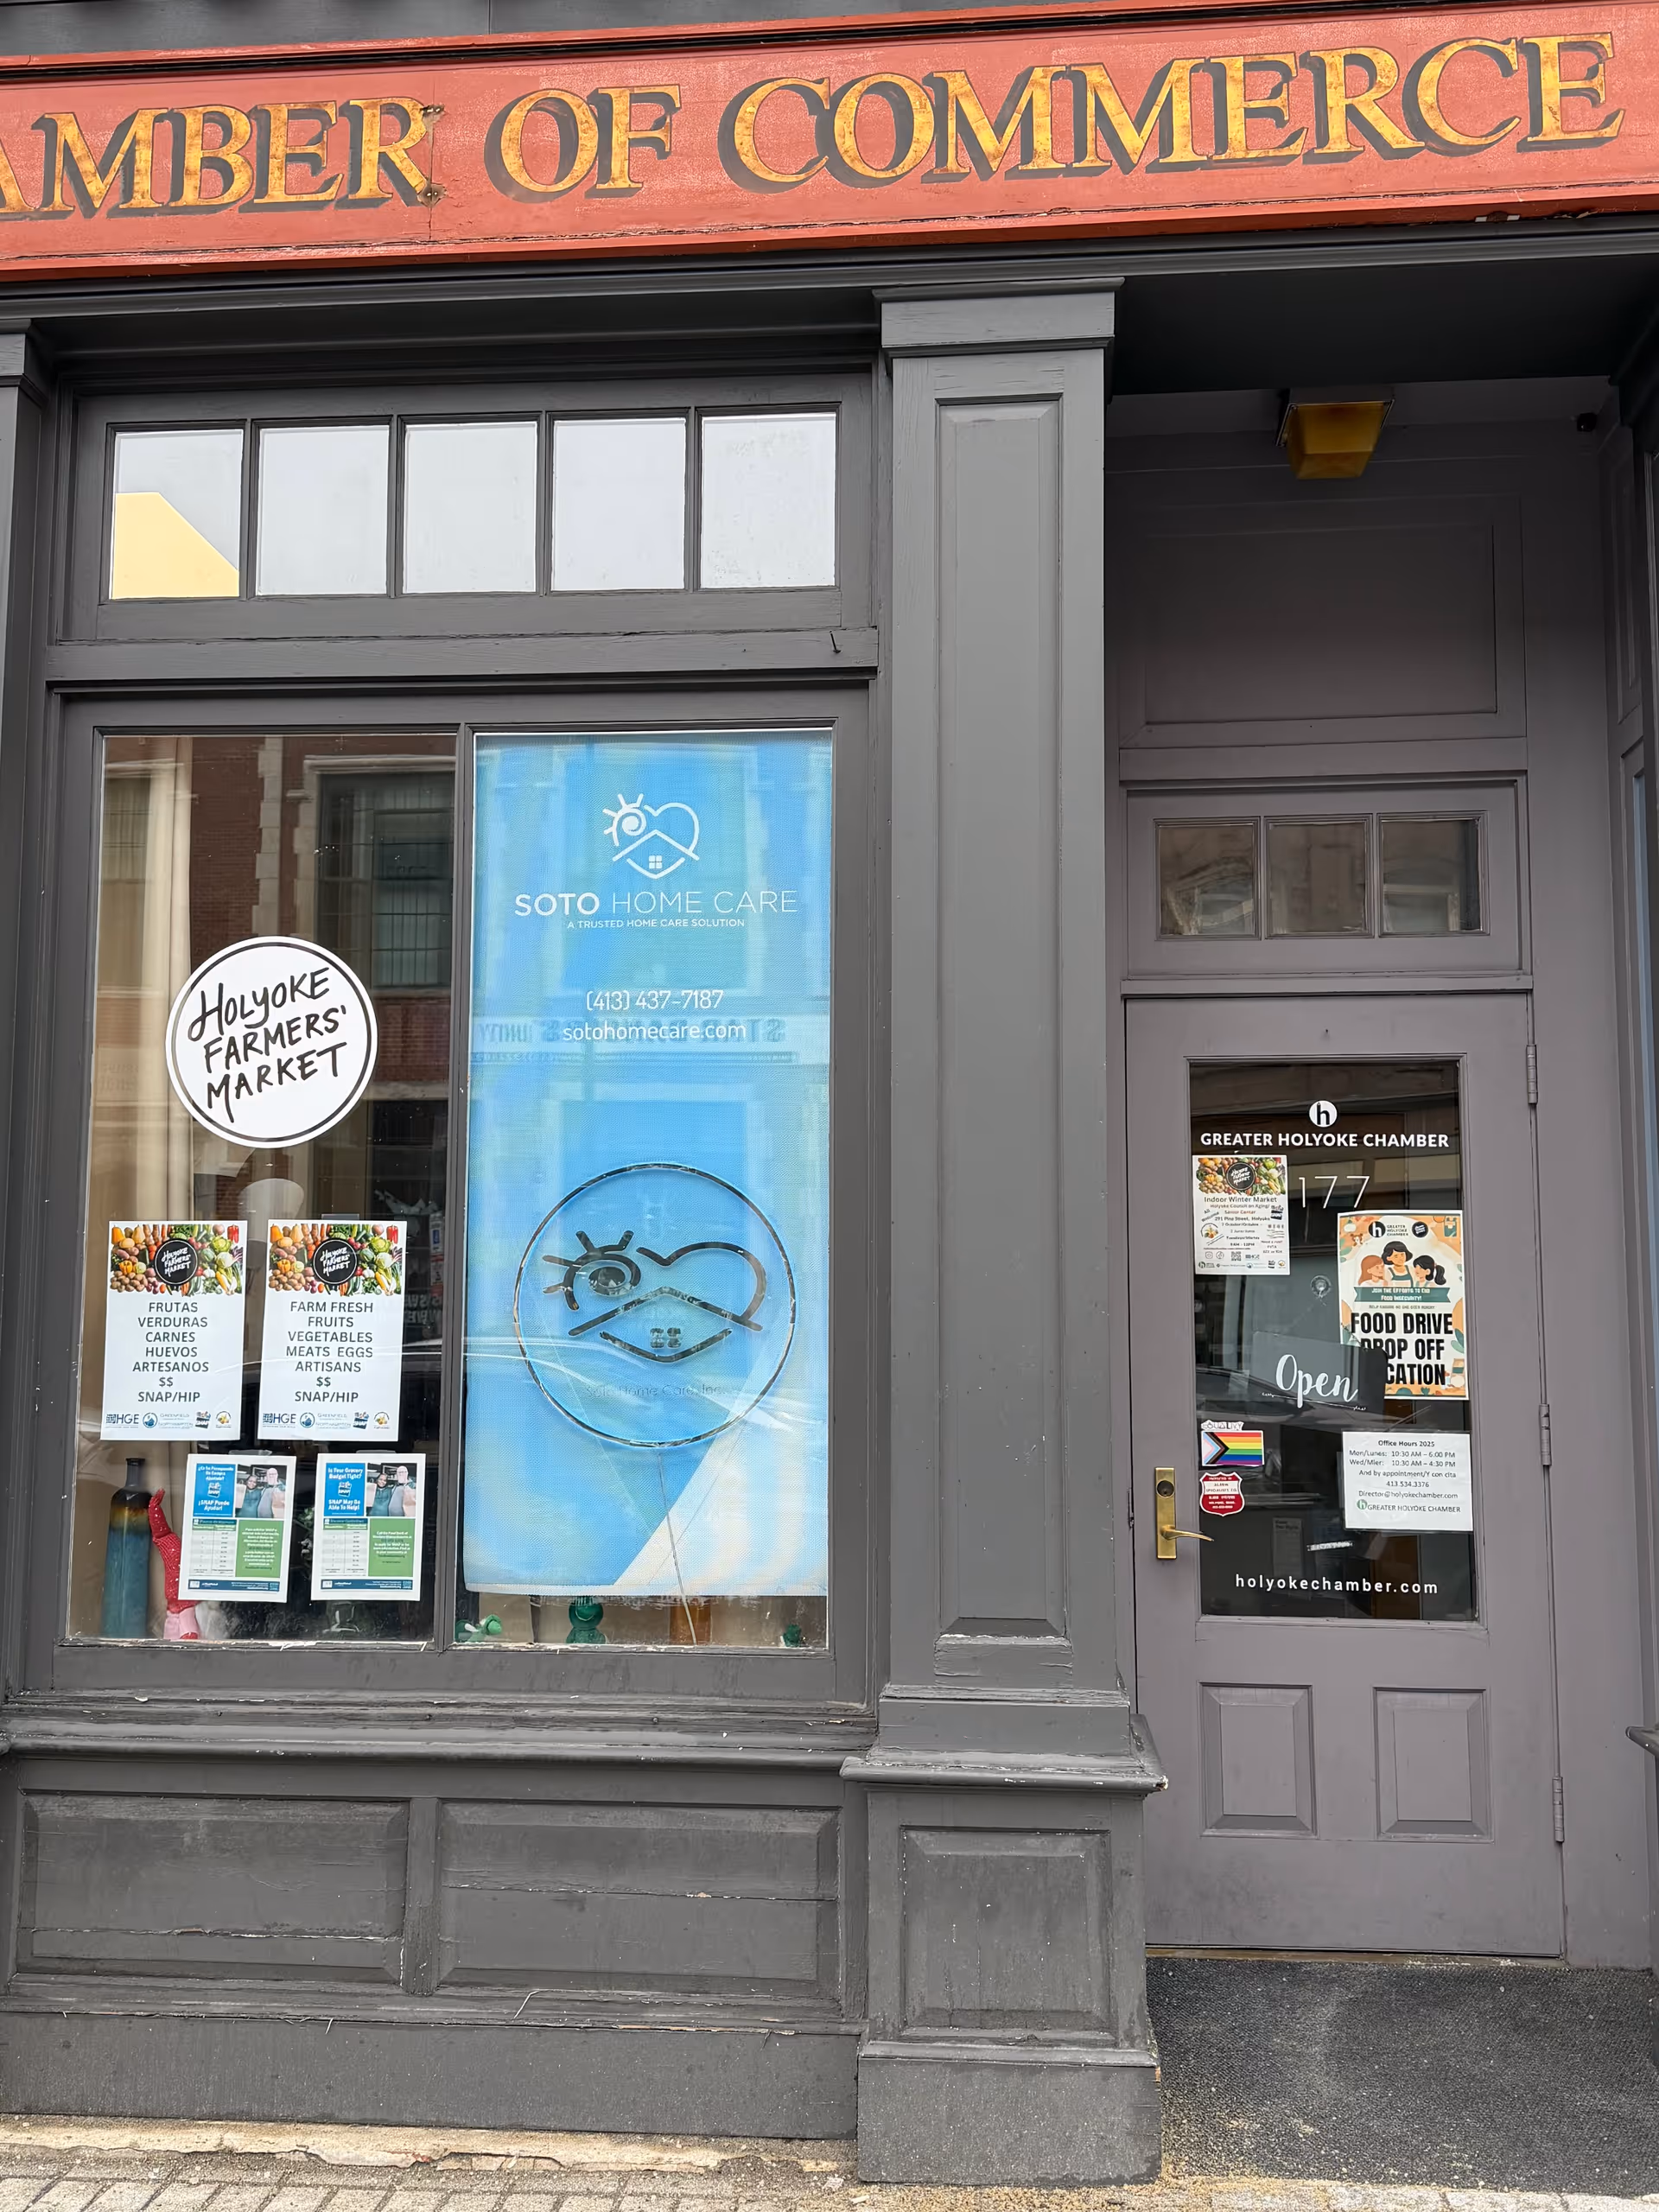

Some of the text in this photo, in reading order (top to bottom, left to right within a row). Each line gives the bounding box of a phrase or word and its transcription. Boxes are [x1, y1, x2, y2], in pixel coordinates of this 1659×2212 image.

[486, 84, 682, 203] OF
[719, 32, 1625, 193] COMMERCE
[514, 890, 798, 916] SOTO HOME CARE
[567, 918, 745, 929] A TRUSTED HOME CARE SOLUTION
[187, 967, 330, 1042] HOLYOKE
[586, 989, 724, 1011] (413) 437-7187
[563, 1020, 747, 1041] sotohomecare.com
[203, 1004, 347, 1073] FARMERS'
[207, 1041, 347, 1124] MARKET
[1200, 1132, 1450, 1148] GREATER HOLYOKE CHAMBER
[1299, 1175, 1370, 1209] 177
[149, 1301, 199, 1313] FRUTAS
[290, 1301, 373, 1313] FARM FRESH
[137, 1317, 208, 1328] VERDURAS
[308, 1316, 354, 1328] FRUITS
[1351, 1312, 1453, 1335] FOOD DRIVE
[145, 1332, 195, 1343] CARNES
[288, 1332, 373, 1343] VEGETABLES
[145, 1346, 198, 1357] HUEVOS
[286, 1346, 373, 1358] MEATS EGGS
[1414, 1338, 1445, 1360] OFF
[132, 1361, 209, 1373] ARTESANOS
[295, 1361, 361, 1373] ARTISANS
[1385, 1363, 1446, 1385] CATION
[159, 1376, 174, 1388] $$
[316, 1376, 332, 1388] $$
[1275, 1353, 1359, 1408] Open
[137, 1391, 200, 1403] SNAP/HIP
[295, 1391, 359, 1403] SNAP/HIP
[116, 1414, 140, 1424] HGE
[273, 1413, 296, 1424] HGE
[1358, 1491, 1459, 1499] Director@holyokechamber.com
[1235, 1573, 1438, 1594] holyokechamber.com
